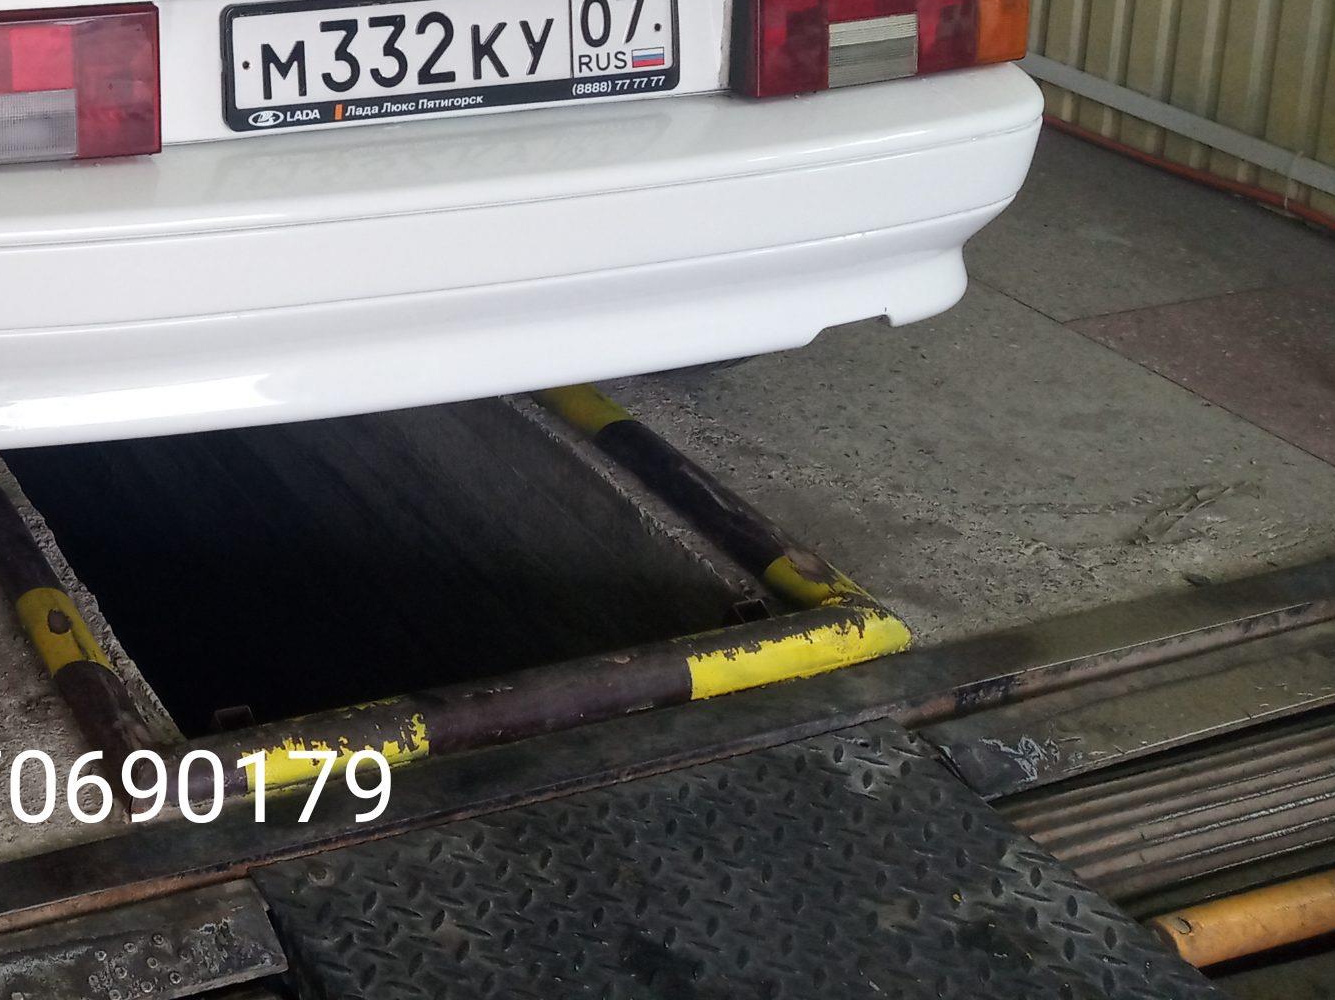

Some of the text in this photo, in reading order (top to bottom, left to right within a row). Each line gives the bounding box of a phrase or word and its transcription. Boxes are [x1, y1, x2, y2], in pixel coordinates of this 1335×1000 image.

[260, 10, 555, 101] М332КУ
[578, 51, 627, 74] RUS
[571, 75, 666, 96] (8888) 77 77 77
[286, 108, 321, 123] LADA
[344, 94, 485, 117] Лада Люкс Пятигорск
